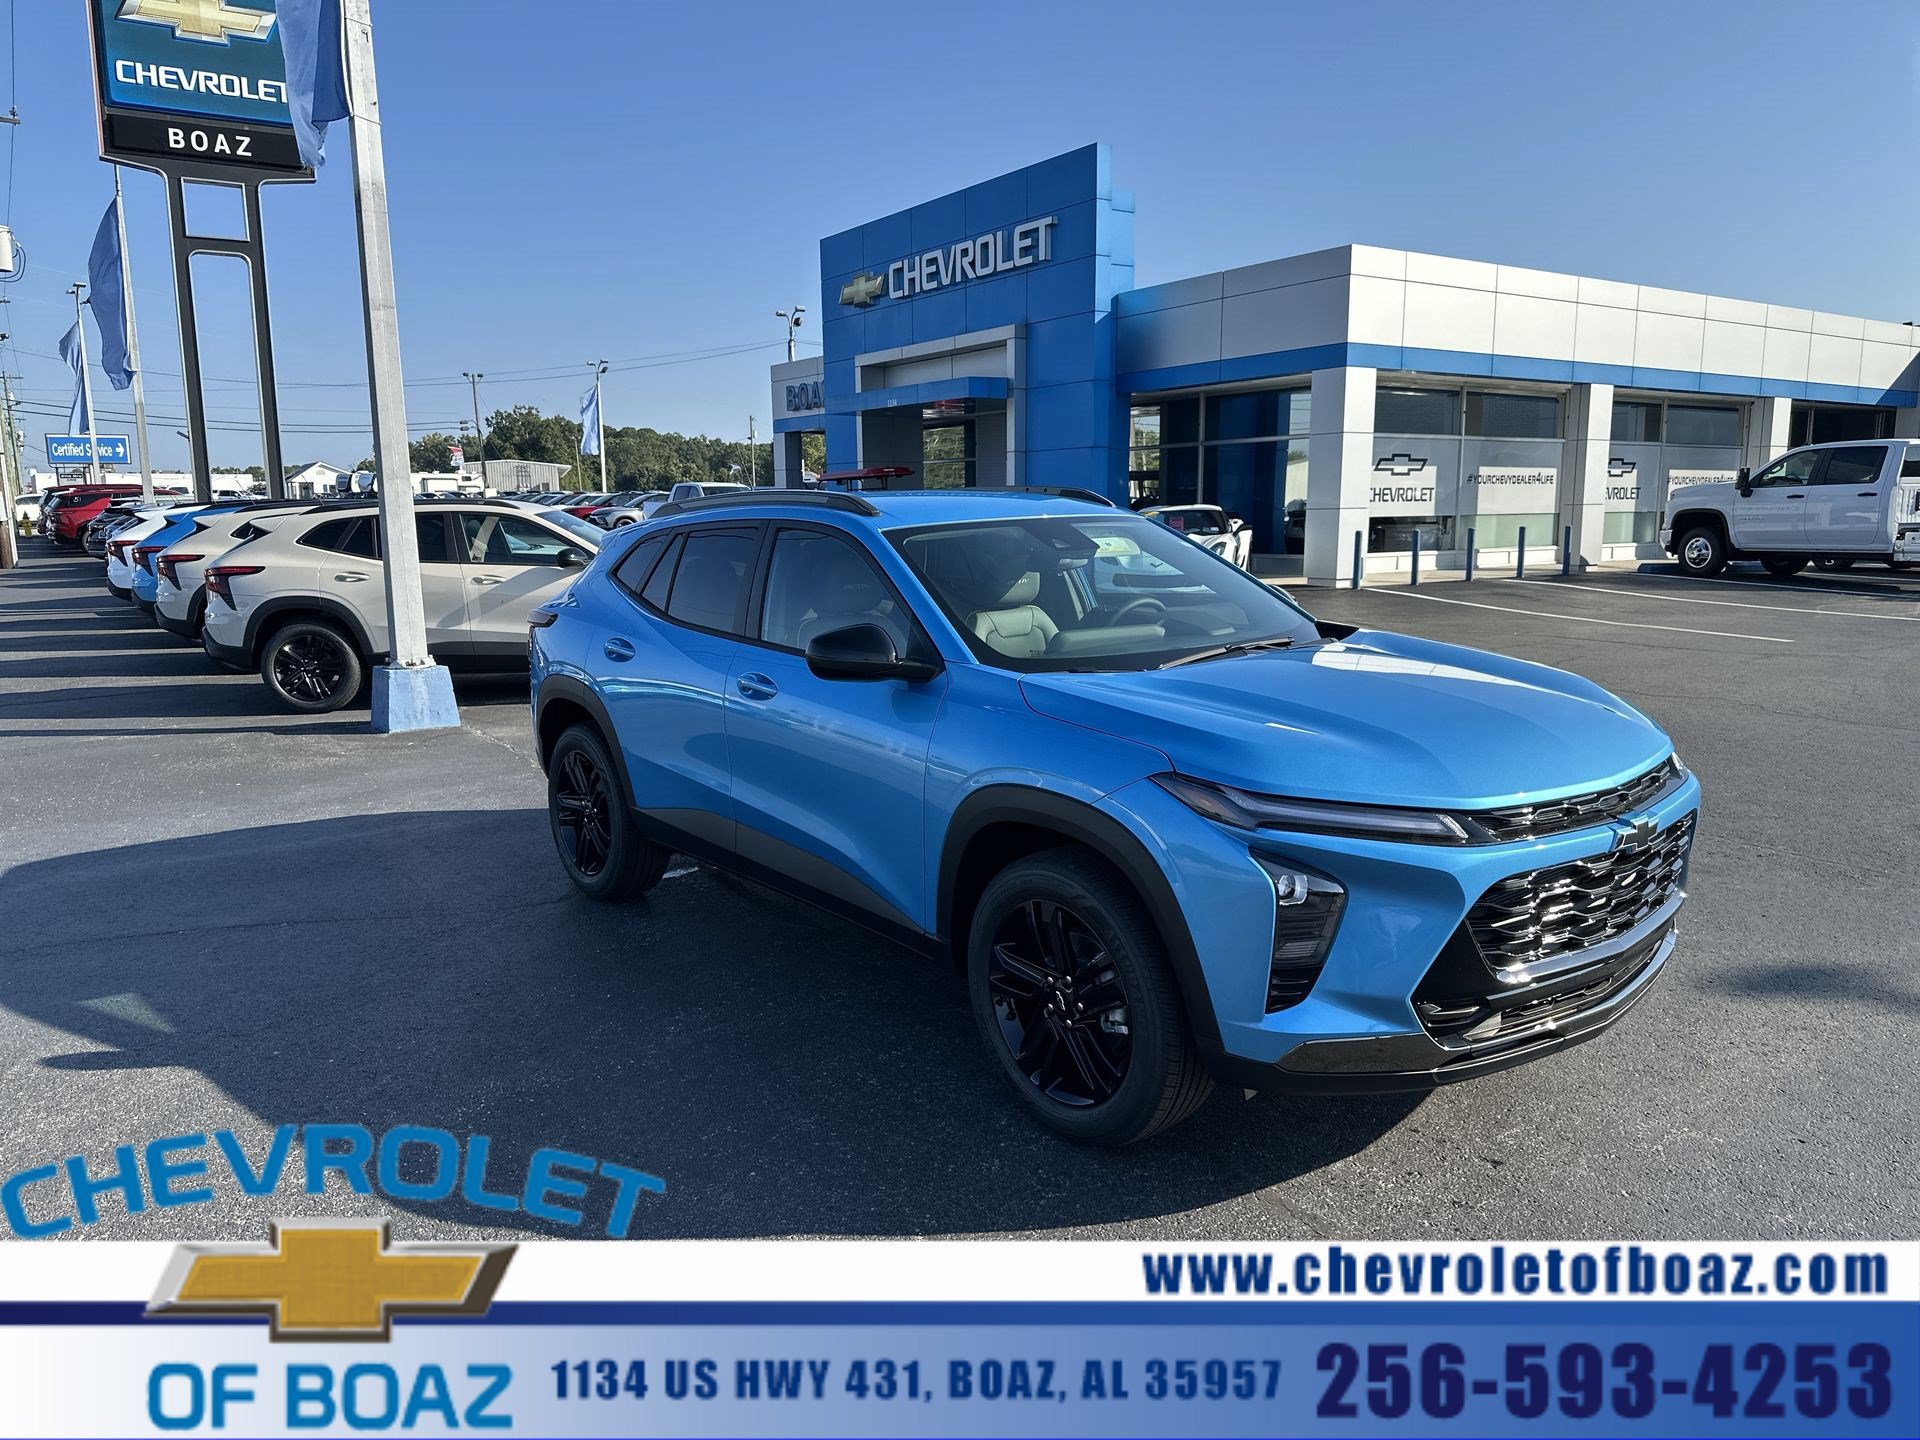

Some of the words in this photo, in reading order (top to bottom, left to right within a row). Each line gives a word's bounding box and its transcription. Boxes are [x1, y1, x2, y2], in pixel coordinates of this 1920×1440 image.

[115, 59, 288, 104] CHEVROLET
[167, 127, 252, 157] BOAZ
[888, 216, 1058, 299] CHEVROLET
[785, 381, 825, 412] BOA
[52, 443, 84, 457] Certified
[86, 443, 112, 457] Svice
[1466, 472, 1554, 485] #YOURCHEVYDEALER4LIFE
[1369, 487, 1434, 502] HEVROLET
[1605, 487, 1641, 500] VROLET
